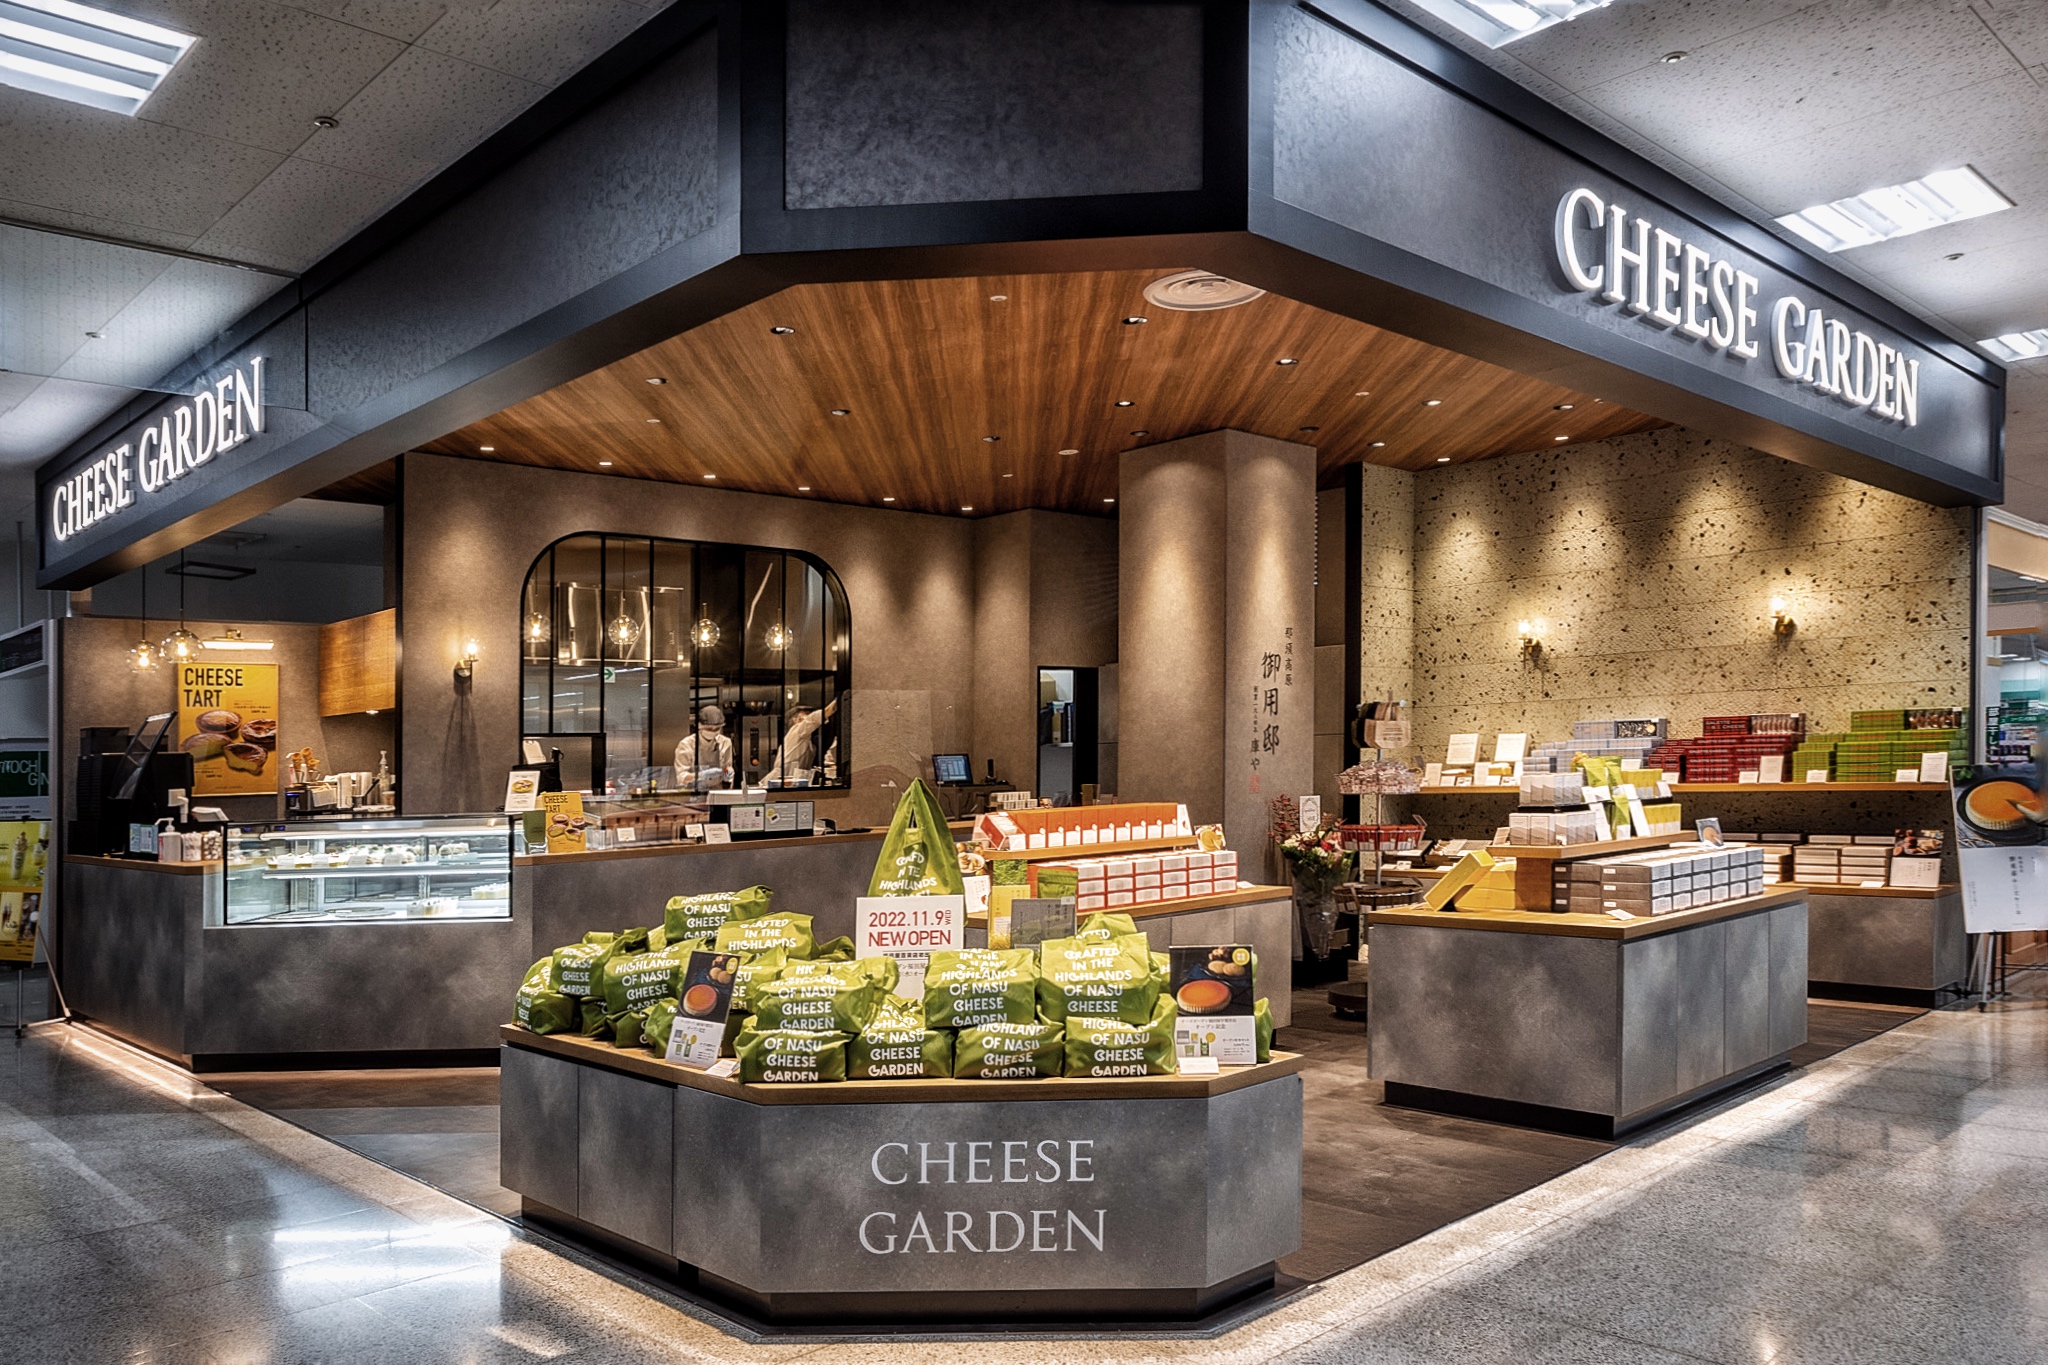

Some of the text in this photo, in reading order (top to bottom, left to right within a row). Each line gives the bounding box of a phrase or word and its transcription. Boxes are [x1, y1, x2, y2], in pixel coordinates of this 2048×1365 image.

[1556, 187, 1920, 427] CHEESE GARDEN
[53, 356, 263, 541] CHEESE GARDEN
[184, 667, 243, 686] CHEESE
[183, 689, 222, 707] TART
[1261, 651, 1281, 755] 御用邸
[544, 794, 568, 804] CHEESE
[545, 804, 561, 813] TART
[879, 877, 938, 891] HIGHLANDS
[684, 903, 731, 915] OF NASU
[686, 917, 726, 928] CHEESE
[869, 909, 952, 928] 2022.11.9 WED
[744, 928, 782, 938] IN THE
[868, 929, 951, 947] NEW OPEN
[728, 937, 797, 951] HIGHLANDS
[960, 952, 973, 960] IN
[1063, 947, 1121, 960] CRAFTED
[615, 959, 680, 974] HIGHLANDS
[1071, 957, 1114, 971] IN THE
[562, 971, 590, 982] CHEESE
[622, 969, 671, 987] OF NASU
[736, 971, 752, 982] SU
[941, 967, 1018, 981] HIGHLANDS
[1055, 969, 1133, 982] HIGHLANDS
[559, 984, 591, 995] GARDEN
[626, 983, 669, 1000] CHEESE
[778, 985, 837, 999] OF NASU
[949, 981, 1009, 996] OF NASU
[1063, 983, 1123, 997] OF NASU
[781, 1001, 832, 1015] CHEESE
[953, 997, 1005, 1012] CHEESE
[1067, 1000, 1119, 1013] CHEESE
[780, 1017, 834, 1030] GARDEN
[764, 1037, 822, 1052] OF NASU
[866, 1031, 925, 1045] OF NASU
[982, 1036, 1040, 1052] OF NASU
[1090, 1033, 1150, 1046] OF NASU
[766, 1053, 817, 1068] CHEESE
[870, 1047, 921, 1061] CHEESE
[983, 1052, 1034, 1067] CHEESE
[1094, 1047, 1144, 1062] CHEESE
[763, 1069, 819, 1083] GARDEN
[868, 1063, 924, 1077] GARDEN
[980, 1066, 1037, 1079] GARDEN
[1091, 1063, 1148, 1078] GARDEN
[871, 1139, 1095, 1185] CHEESE
[859, 1209, 1107, 1255] GARDEN
